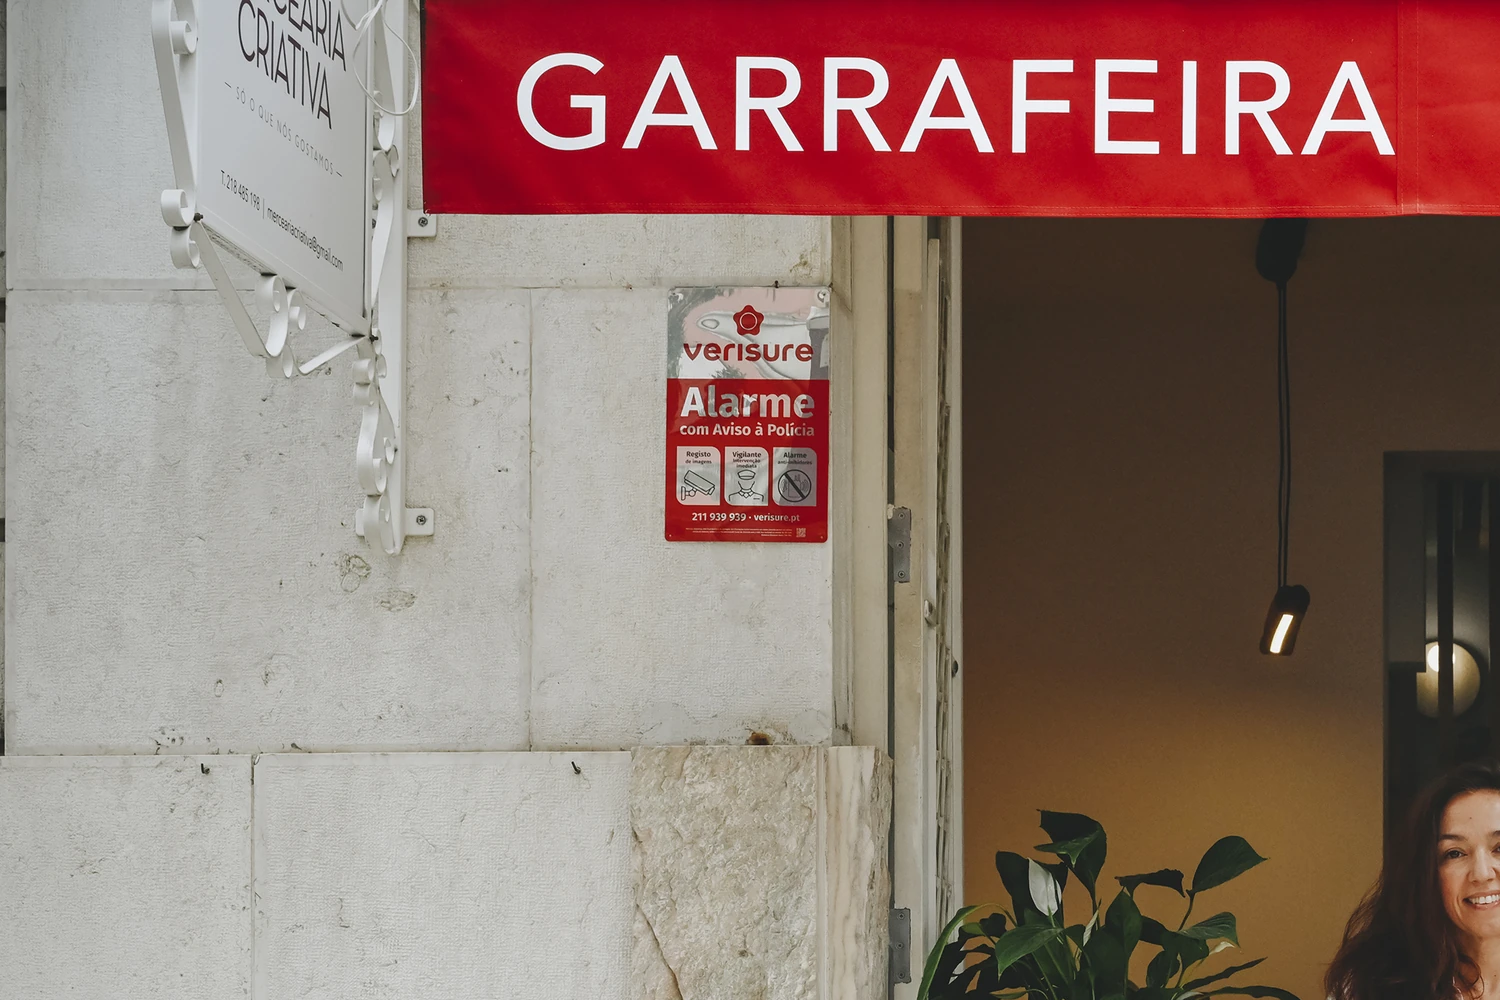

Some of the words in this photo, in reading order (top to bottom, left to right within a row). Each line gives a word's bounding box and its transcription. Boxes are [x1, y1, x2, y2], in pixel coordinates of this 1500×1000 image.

[239, 0, 332, 130] CRIATIVA
[516, 52, 1396, 156] GARRAFEIRA
[236, 86, 246, 105] SÓ
[249, 97, 255, 112] O
[258, 104, 273, 128] QUE
[277, 121, 291, 142] NÓS
[295, 134, 333, 175] GOSTAMOS
[238, 183, 248, 203] 485
[250, 192, 260, 211] 198
[267, 207, 343, 272] merceariacriativa@gmail.com
[683, 342, 814, 362] verisure
[680, 385, 815, 419] Alarme
[680, 424, 709, 436] com
[713, 422, 750, 437] Aviso
[755, 422, 763, 436] à
[767, 422, 815, 437] Polícia
[686, 451, 711, 459] Registo
[732, 451, 762, 459] Vigilante
[692, 513, 707, 521] 211
[709, 513, 727, 521] 939
[729, 513, 747, 521] 939
[753, 513, 800, 523] verisure.pt
